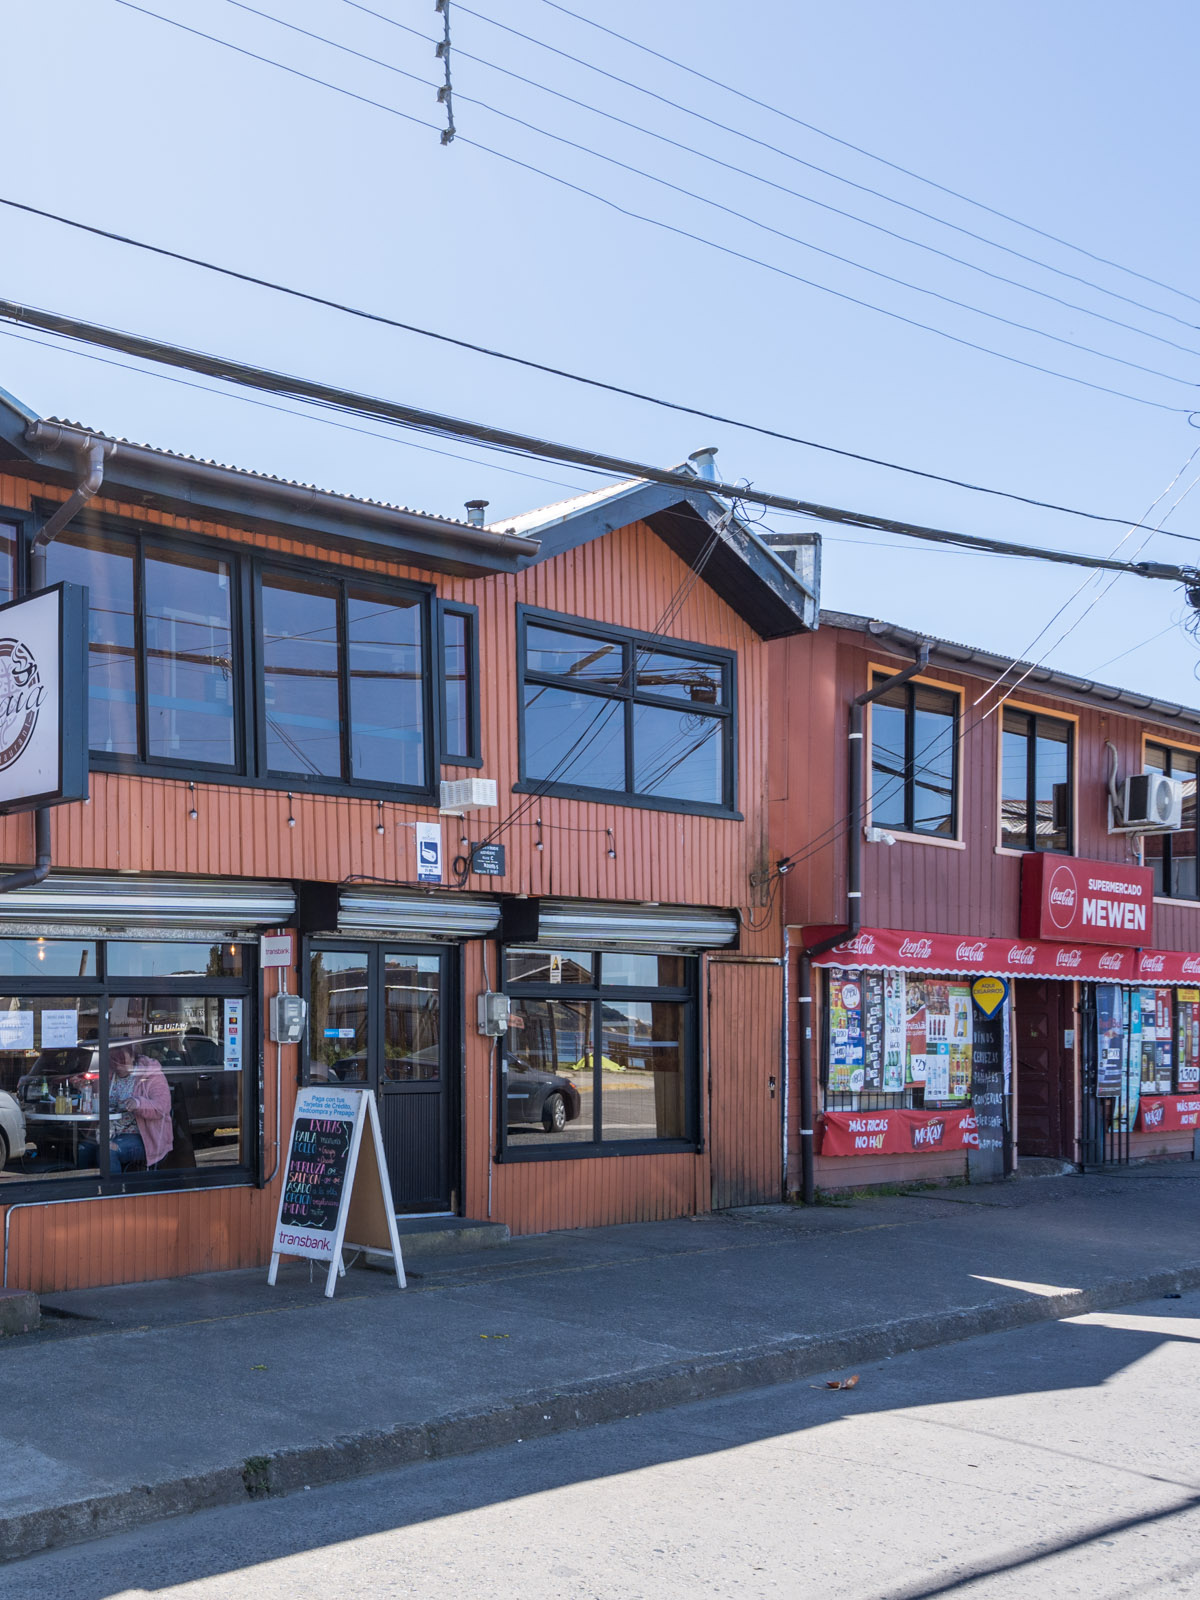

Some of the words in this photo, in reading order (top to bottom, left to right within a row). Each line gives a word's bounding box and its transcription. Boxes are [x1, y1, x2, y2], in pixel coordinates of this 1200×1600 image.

[1088, 878, 1142, 896] SUPERMERCADO
[1082, 897, 1146, 931] MEWEN
[312, 1095, 325, 1103] Paga
[299, 1106, 328, 1114] Redcompra
[334, 1109, 355, 1117] Prepago
[310, 1119, 342, 1134] EXTRAS
[867, 1119, 889, 1132] RICAS
[295, 1131, 317, 1143] PAILA
[855, 1136, 868, 1148] NO
[869, 1134, 886, 1149] HAY
[293, 1142, 317, 1154] POLLO
[290, 1160, 326, 1174] MERLUZA
[287, 1182, 311, 1194] ASADO
